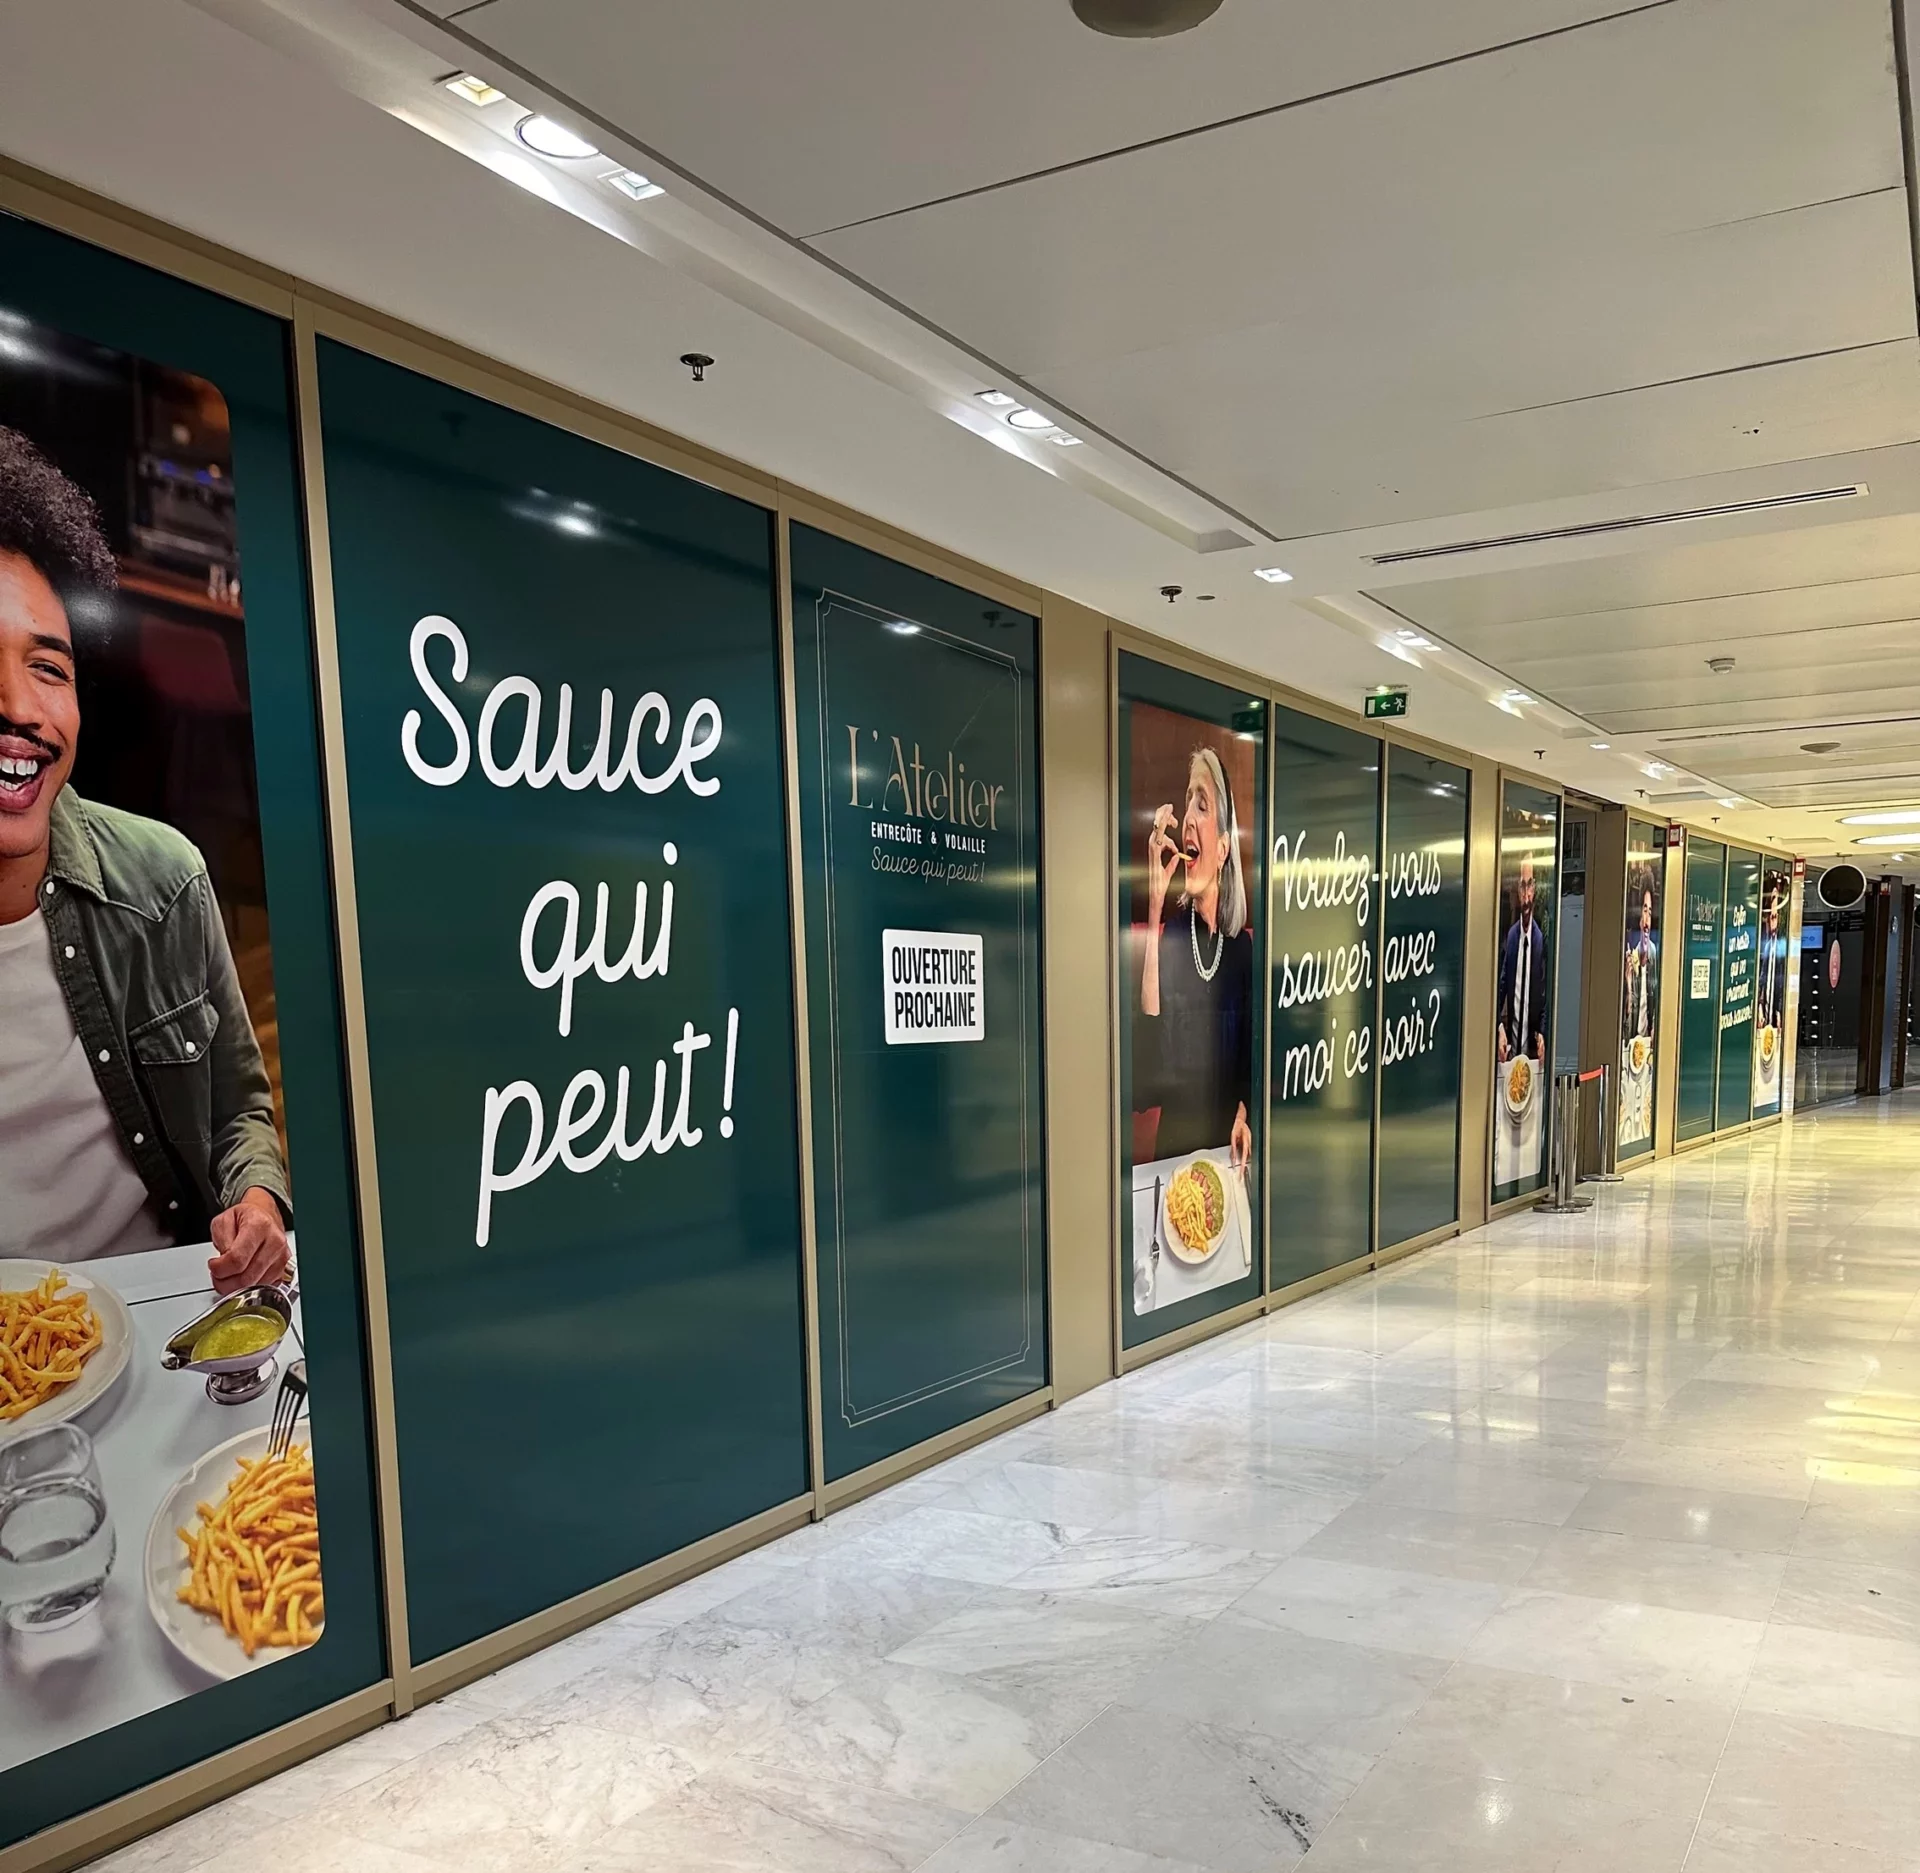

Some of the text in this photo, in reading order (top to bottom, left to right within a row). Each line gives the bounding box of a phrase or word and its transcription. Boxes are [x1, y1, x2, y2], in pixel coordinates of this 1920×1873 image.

[401, 615, 722, 797] Sauce
[845, 724, 1004, 832] L'Atelier
[871, 821, 986, 854] ENTRECÔTE & VOLAILLE
[871, 846, 919, 876] Sauce
[921, 853, 946, 884] qui
[1273, 829, 1441, 927] Voulez-vous
[520, 841, 678, 1038] qui
[892, 945, 976, 986] OUVERTURE
[1278, 930, 1435, 1009] saucer avec
[894, 991, 976, 1029] PROCHAINE
[1282, 988, 1441, 1100] moi ce soir?
